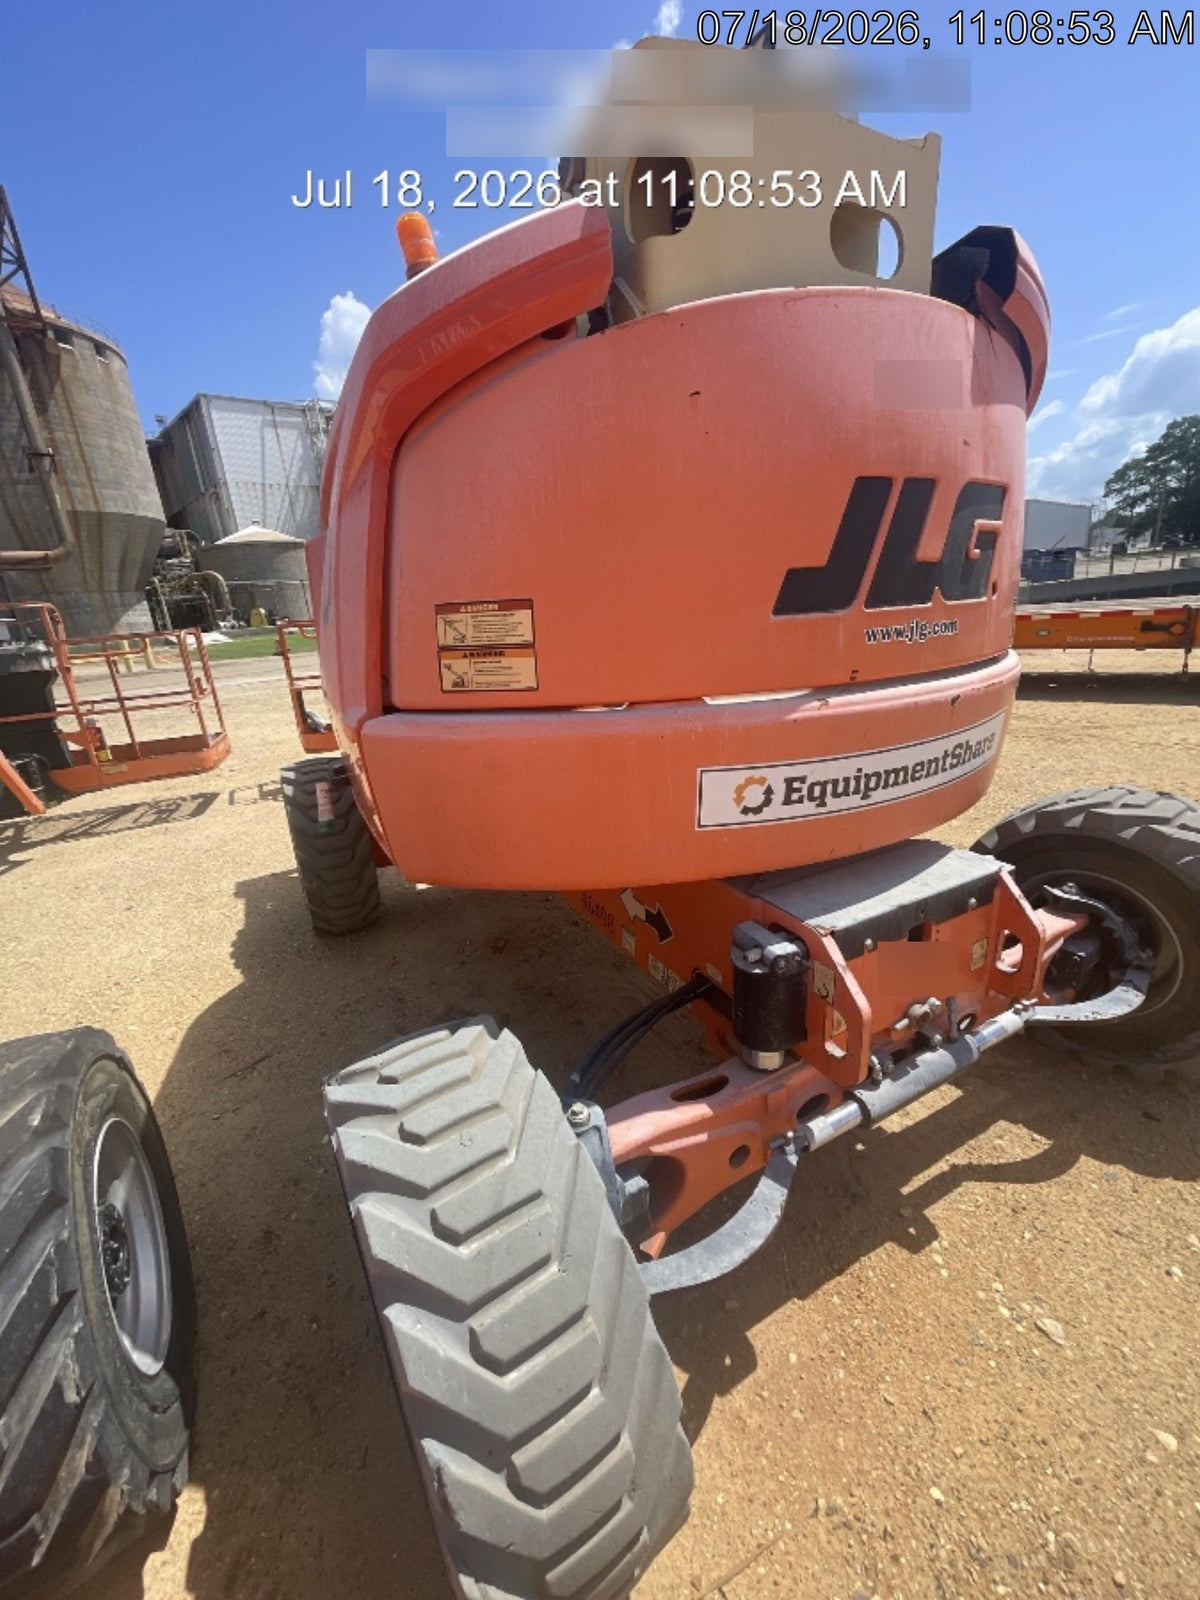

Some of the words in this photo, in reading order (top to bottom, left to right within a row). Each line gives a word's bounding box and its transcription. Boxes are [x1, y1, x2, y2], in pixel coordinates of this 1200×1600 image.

[771, 476, 1008, 616] JLG
[865, 619, 958, 642] www.jlg.com
[781, 731, 996, 808] EquipmentShare
